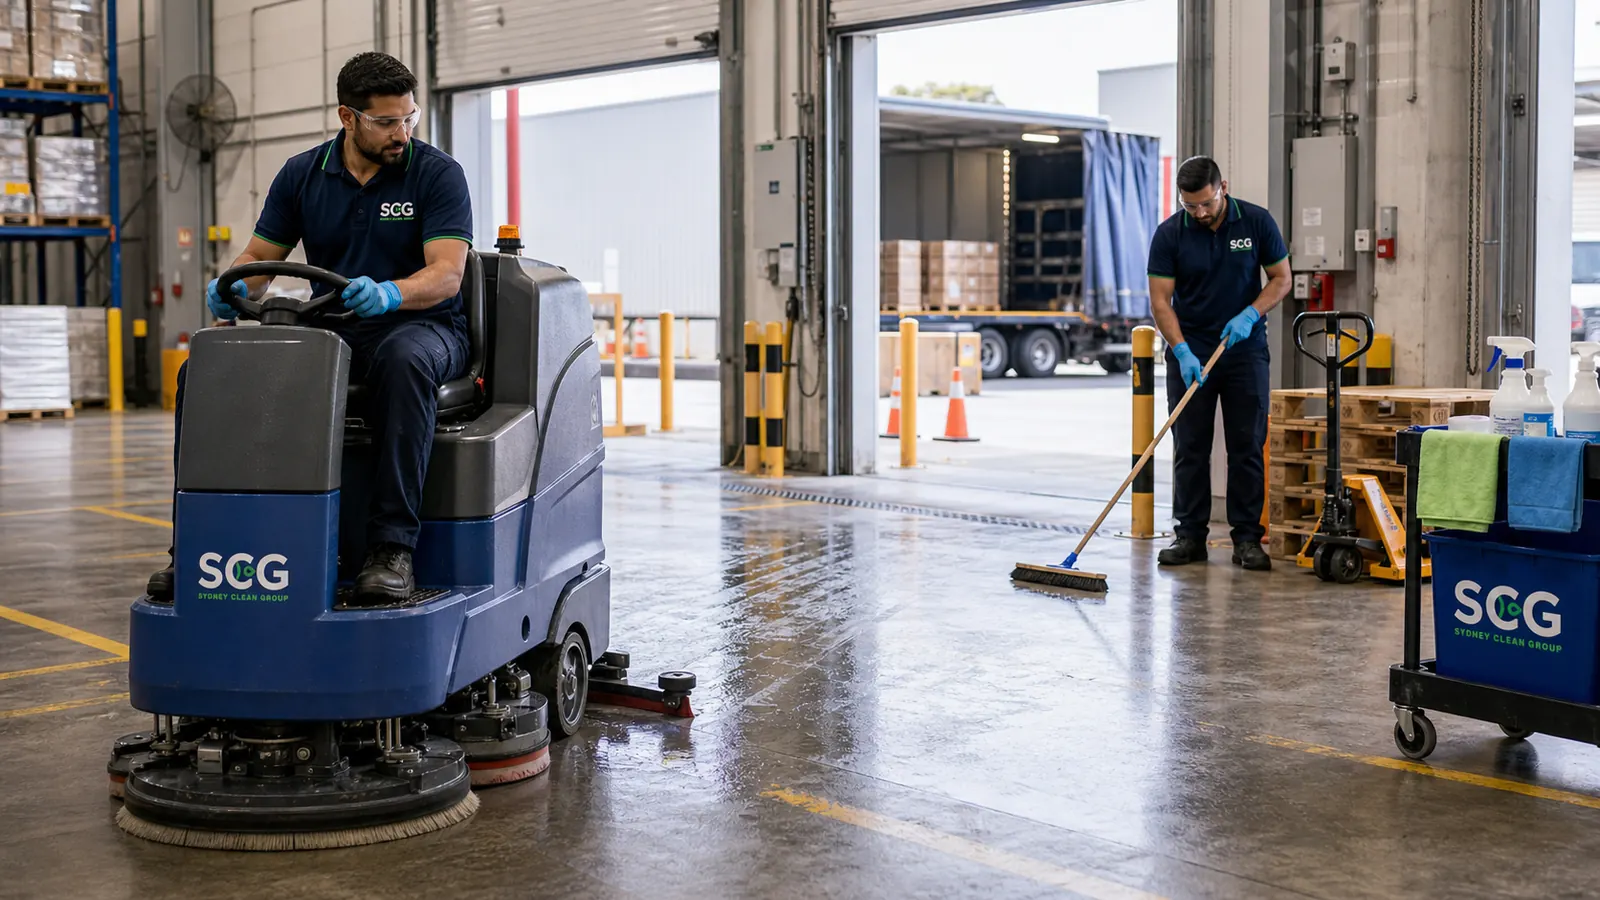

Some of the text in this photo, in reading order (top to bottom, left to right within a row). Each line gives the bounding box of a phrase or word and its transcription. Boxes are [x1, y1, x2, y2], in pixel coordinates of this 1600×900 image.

[380, 202, 414, 217] SCG
[1230, 238, 1252, 249] SCG
[198, 552, 289, 591] SCG
[198, 593, 289, 603] SYDNEY CLEAN GROUP
[1454, 579, 1562, 638] SCG
[1454, 627, 1563, 653] SYDNEY CLEAN GROUP
